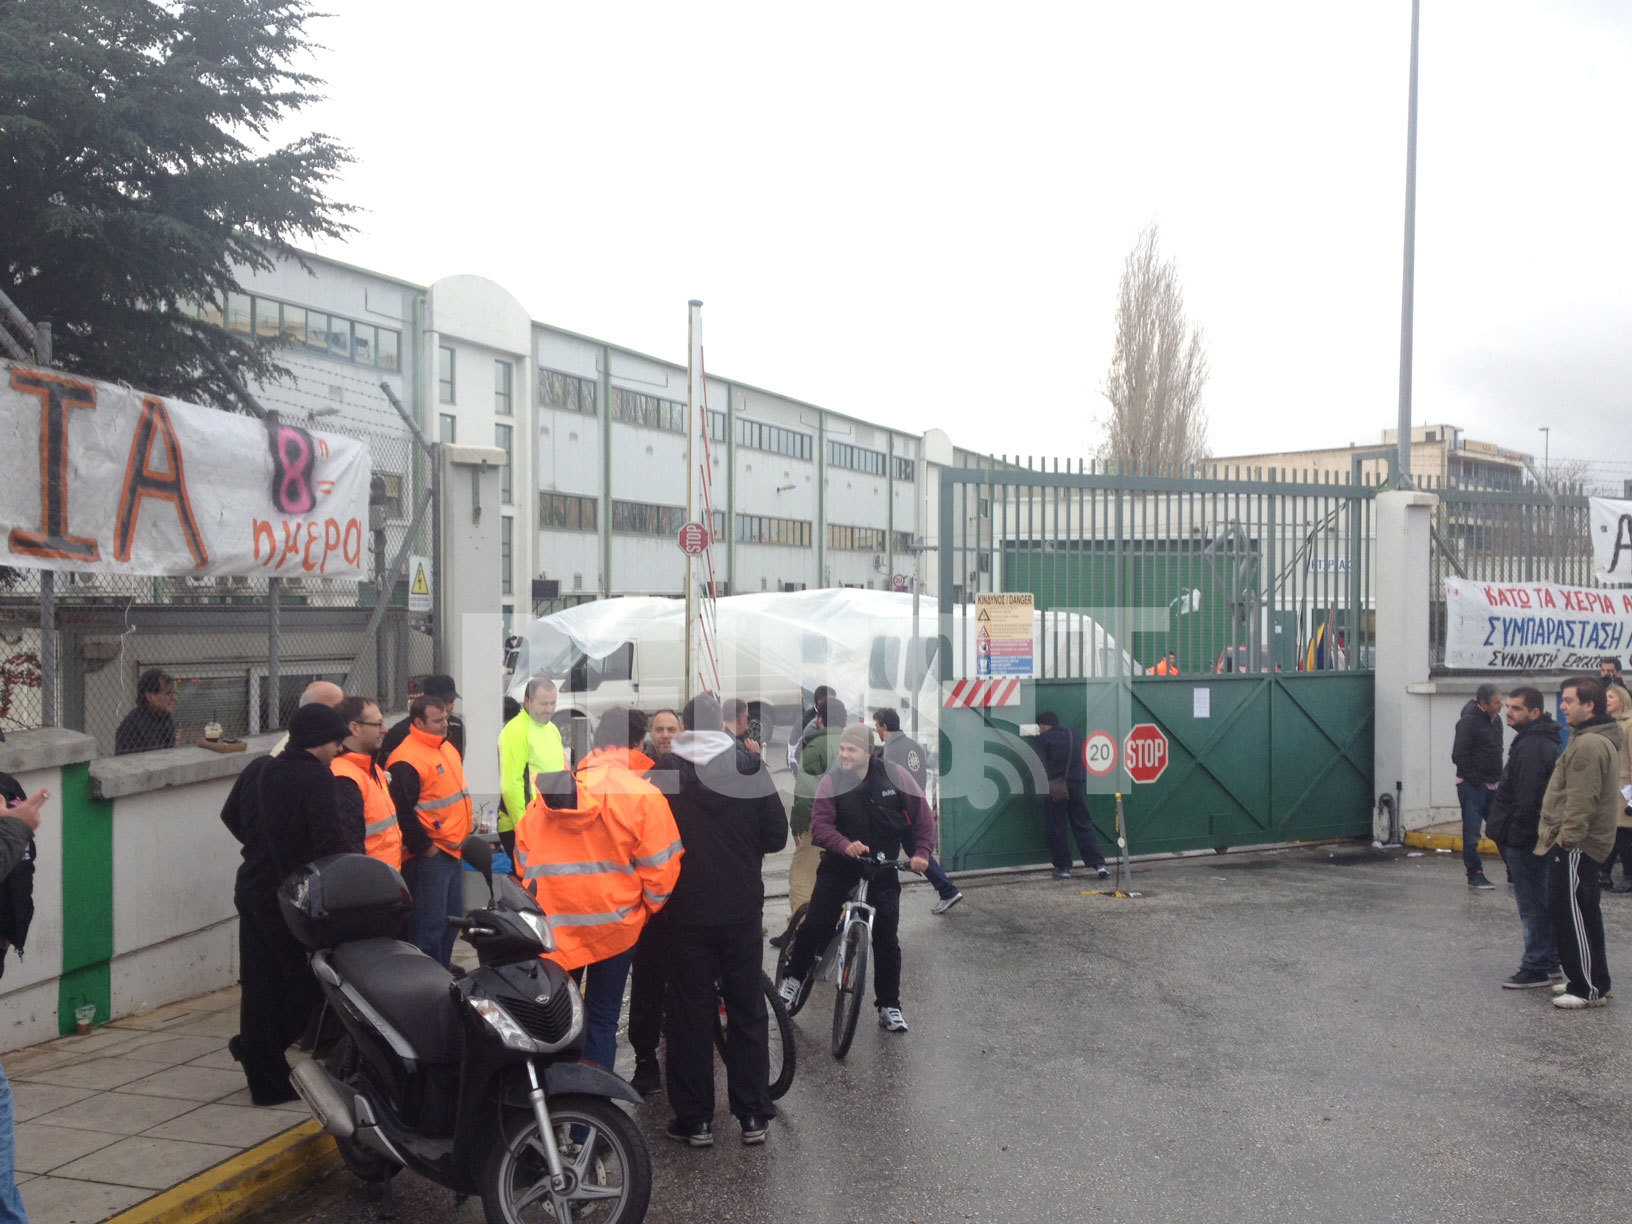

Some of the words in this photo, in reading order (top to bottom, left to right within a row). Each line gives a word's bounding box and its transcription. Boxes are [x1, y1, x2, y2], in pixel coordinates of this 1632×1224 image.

[686, 525, 702, 553] STOP
[1009, 595, 1032, 605] DANGER
[1483, 585, 1532, 609] ΚΑΤΩ
[1532, 587, 1557, 609] ΤΑ
[1558, 589, 1616, 615] ΧΕΡΙΑ
[1483, 616, 1624, 650] ΣΥΜΠΑΡΑΣΤΑΣΗ
[1090, 743, 1110, 762] 20
[1126, 738, 1164, 769] STOP
